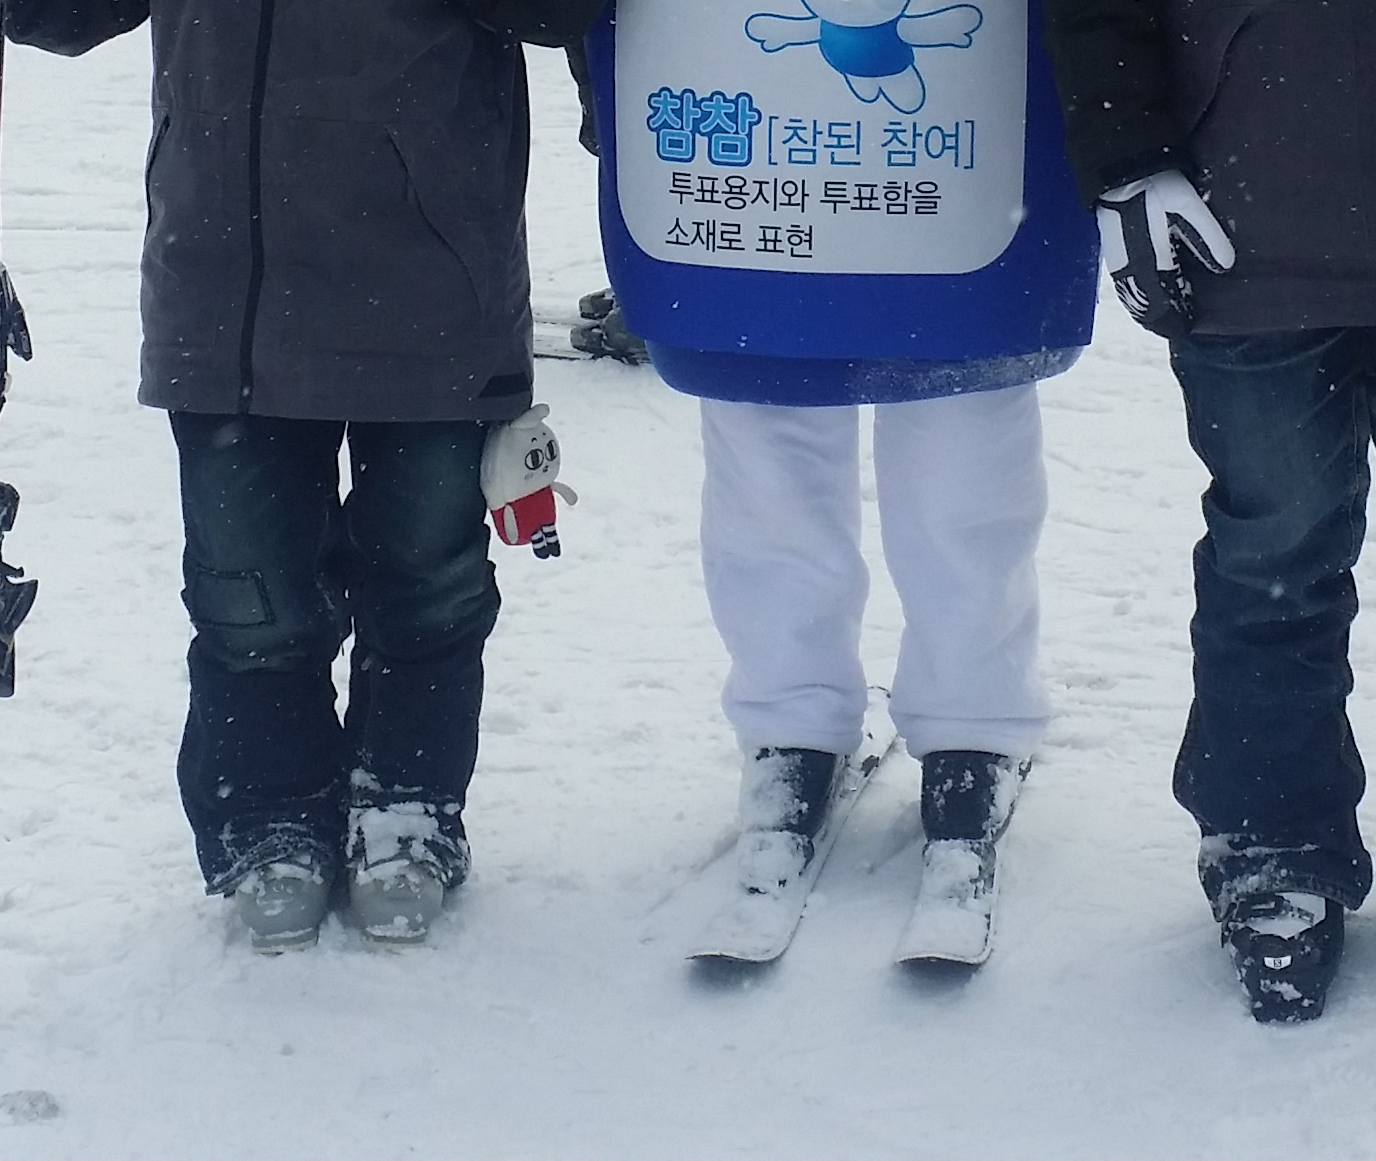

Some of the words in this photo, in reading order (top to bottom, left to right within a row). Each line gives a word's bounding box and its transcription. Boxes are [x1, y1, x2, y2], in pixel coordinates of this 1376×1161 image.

[646, 86, 762, 167] 참참
[668, 172, 810, 213] 투표용지와
[820, 180, 942, 215] 투표함을
[665, 217, 744, 254] 소재로
[756, 224, 814, 258] 표현
